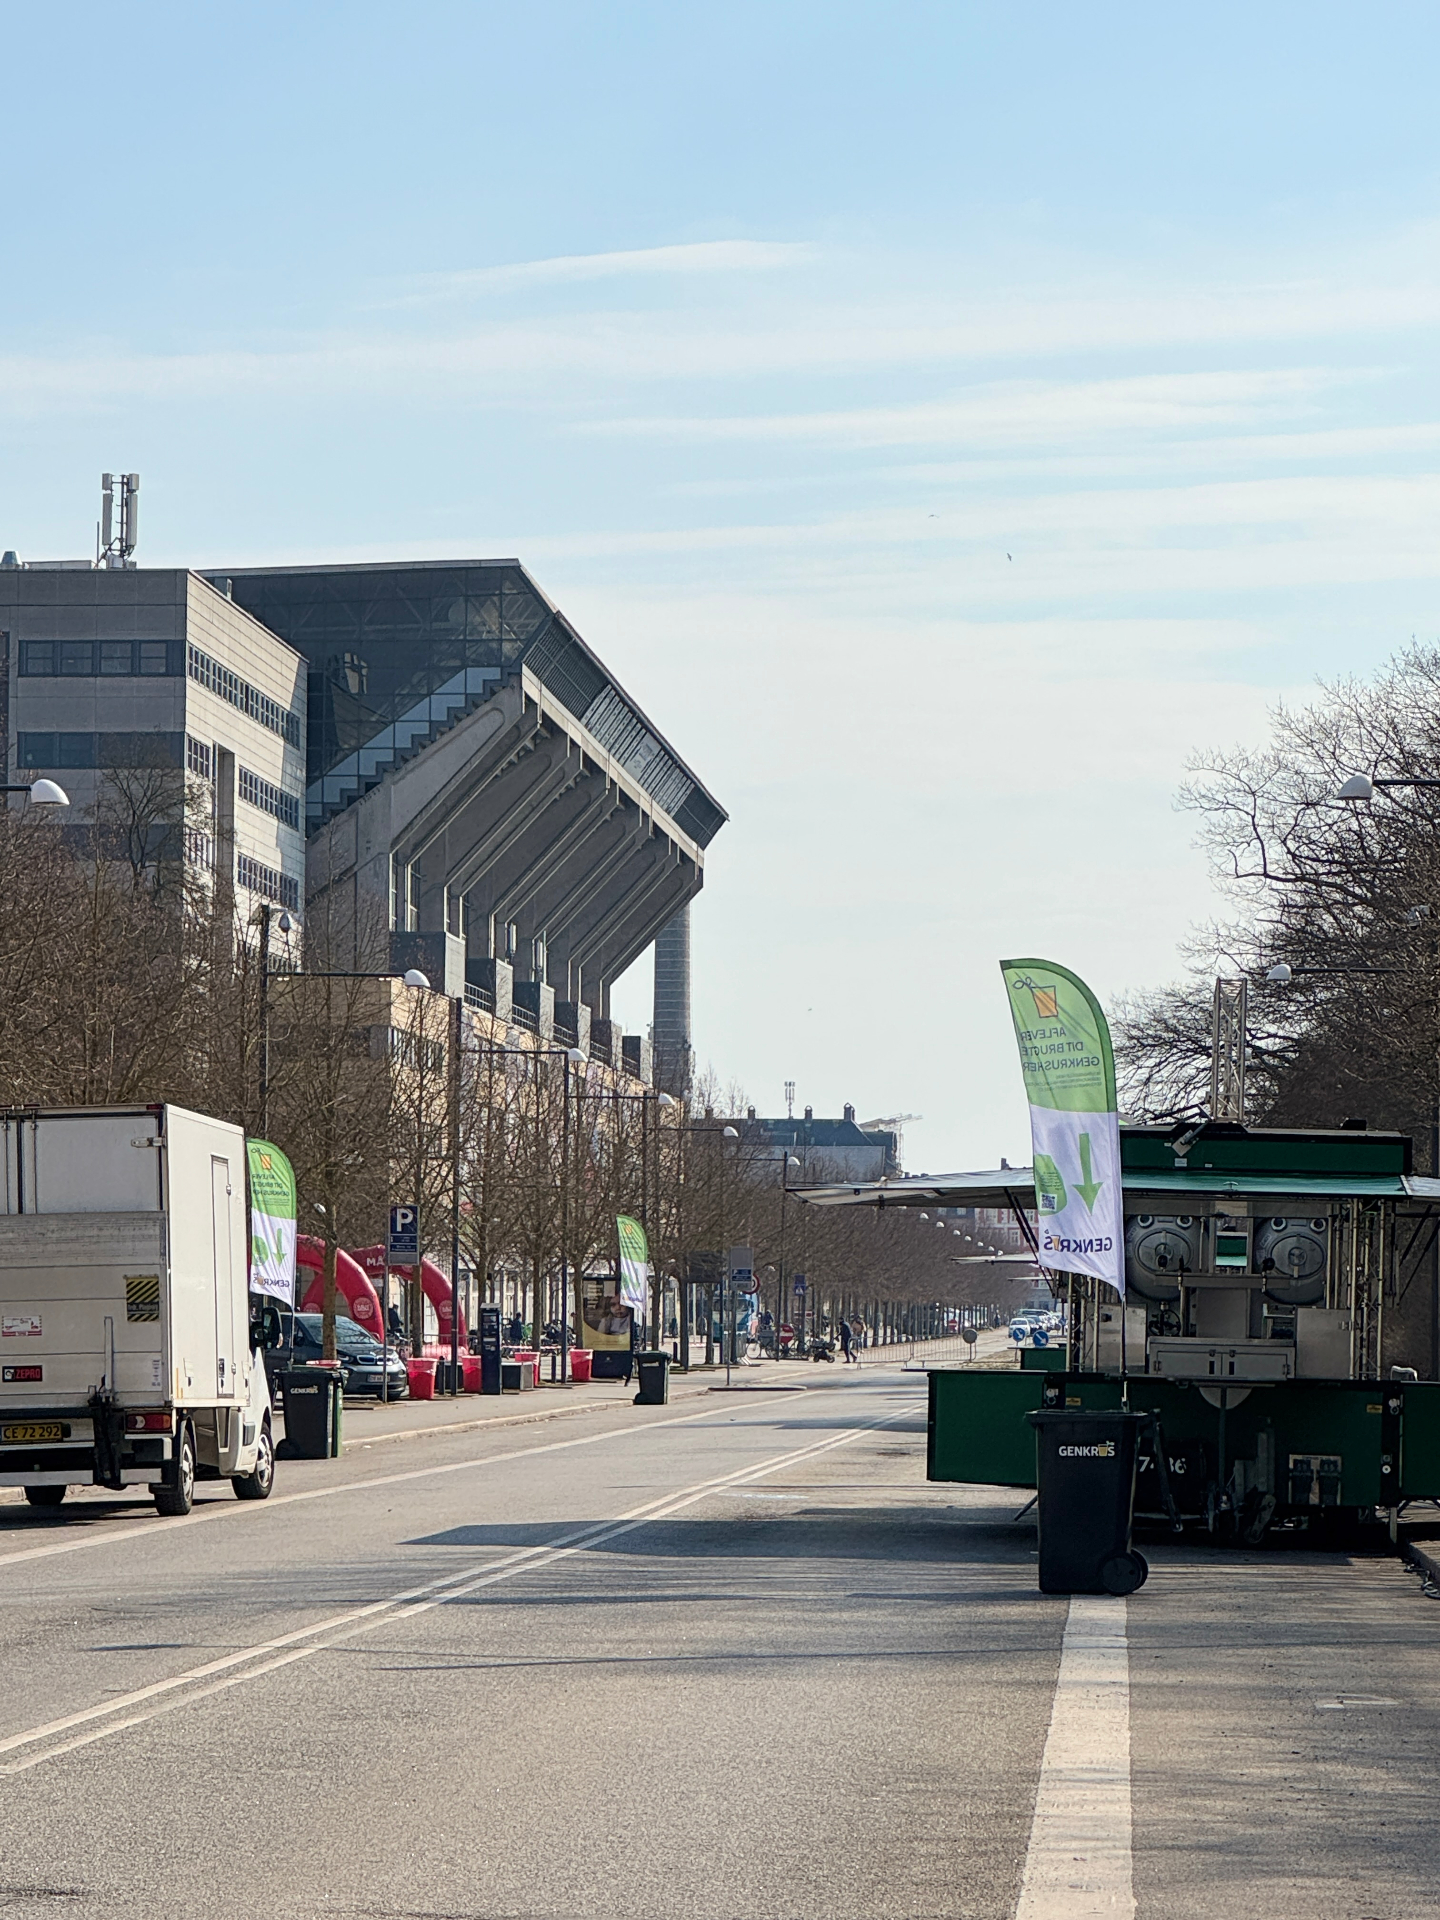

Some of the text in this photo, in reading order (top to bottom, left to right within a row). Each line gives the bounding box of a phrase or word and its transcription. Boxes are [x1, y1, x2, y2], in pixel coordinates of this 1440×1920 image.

[396, 1208, 413, 1232] P
[366, 1255, 386, 1267] MÅ
[15, 1368, 41, 1379] ZEPRO
[3, 1425, 61, 1439] CE 72 292
[1138, 1456, 1187, 1474] 76
